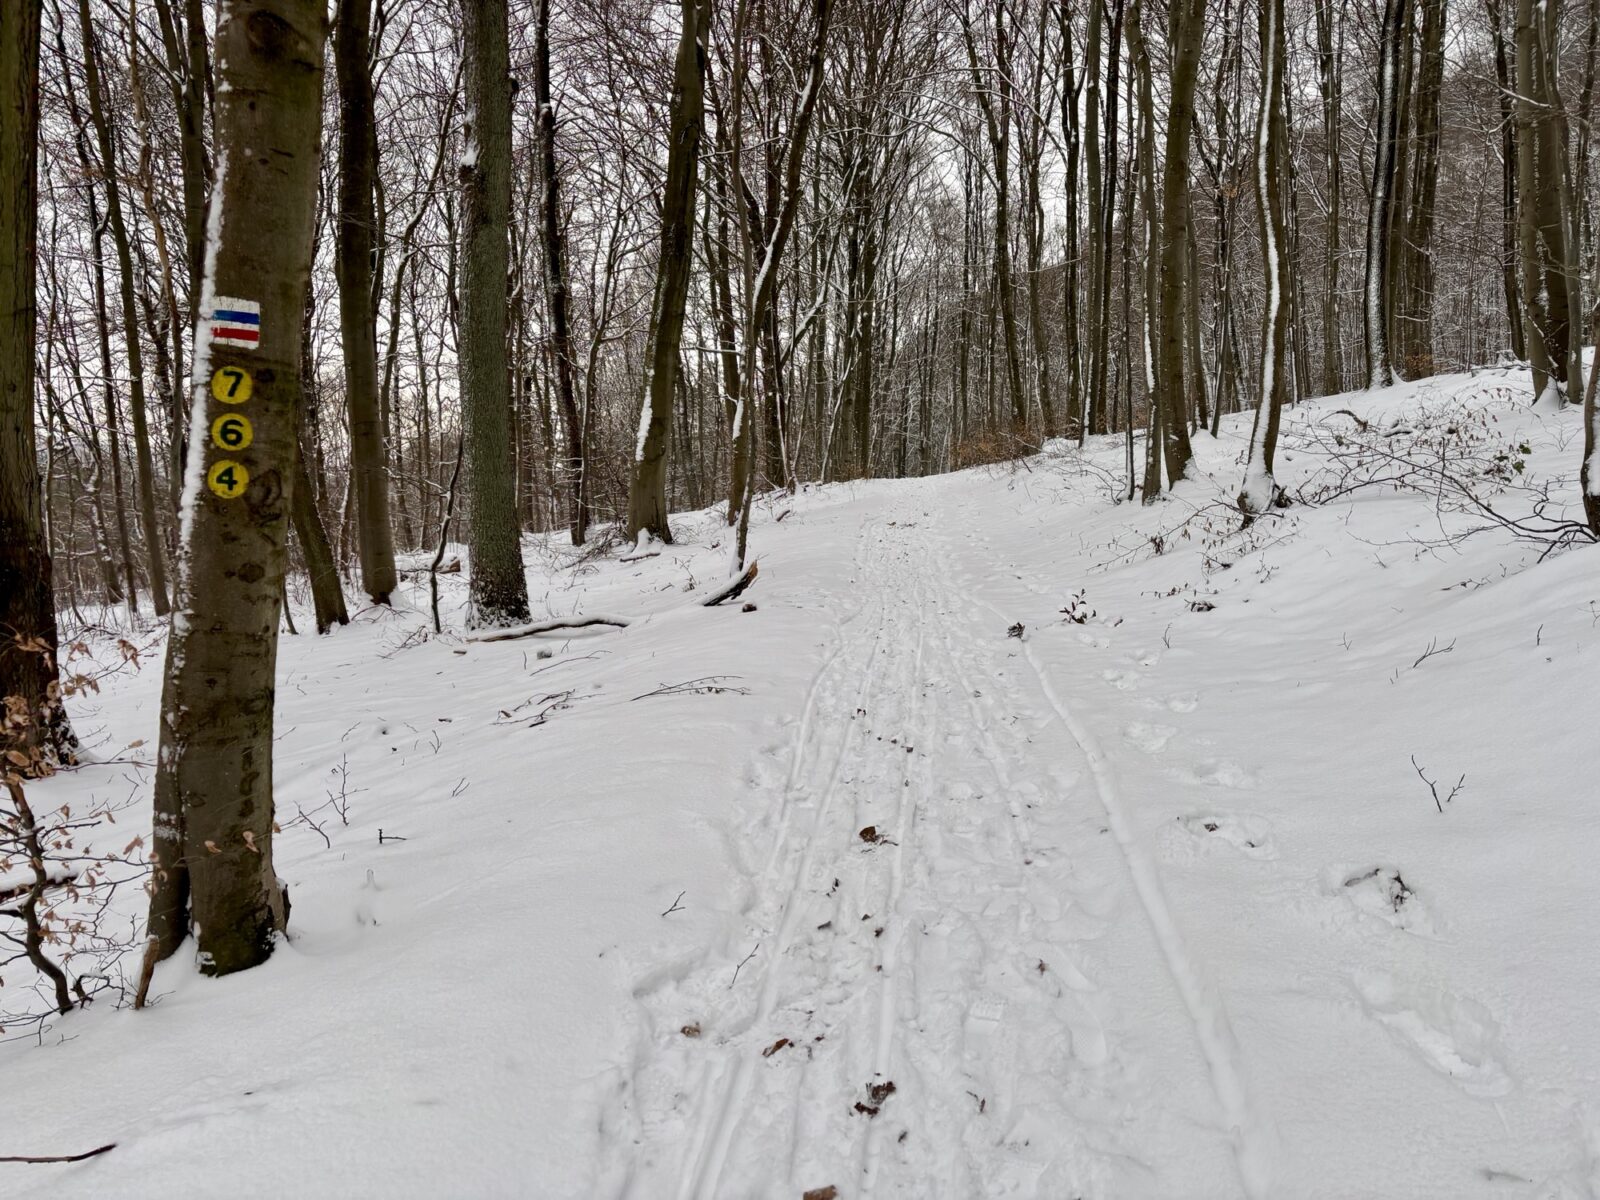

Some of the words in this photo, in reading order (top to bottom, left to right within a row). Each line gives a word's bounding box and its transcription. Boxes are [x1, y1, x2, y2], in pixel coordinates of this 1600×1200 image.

[223, 369, 244, 397] 7
[220, 419, 244, 446] 6
[216, 466, 238, 491] 4
